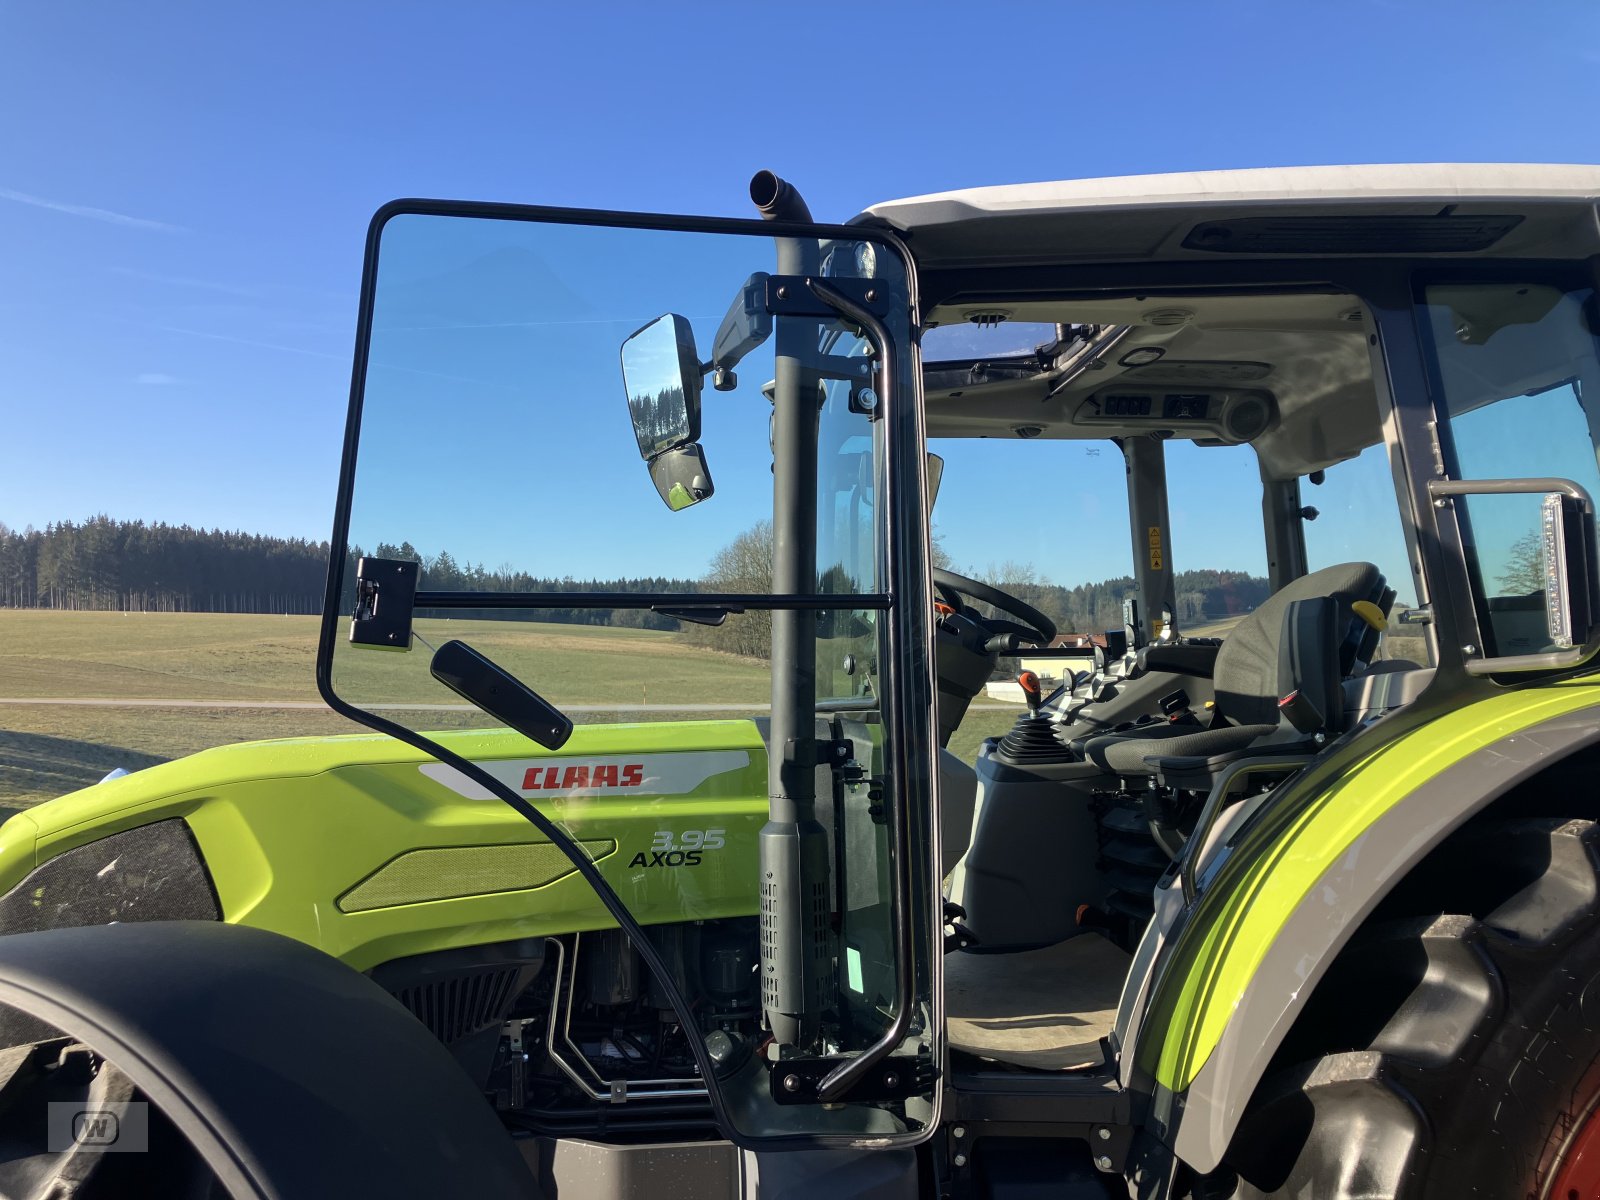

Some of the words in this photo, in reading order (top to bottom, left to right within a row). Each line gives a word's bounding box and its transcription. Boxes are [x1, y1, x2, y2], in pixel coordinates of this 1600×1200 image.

[522, 765, 644, 790] CLAAS
[651, 831, 726, 850] 3.95
[628, 851, 703, 868] AXOS
